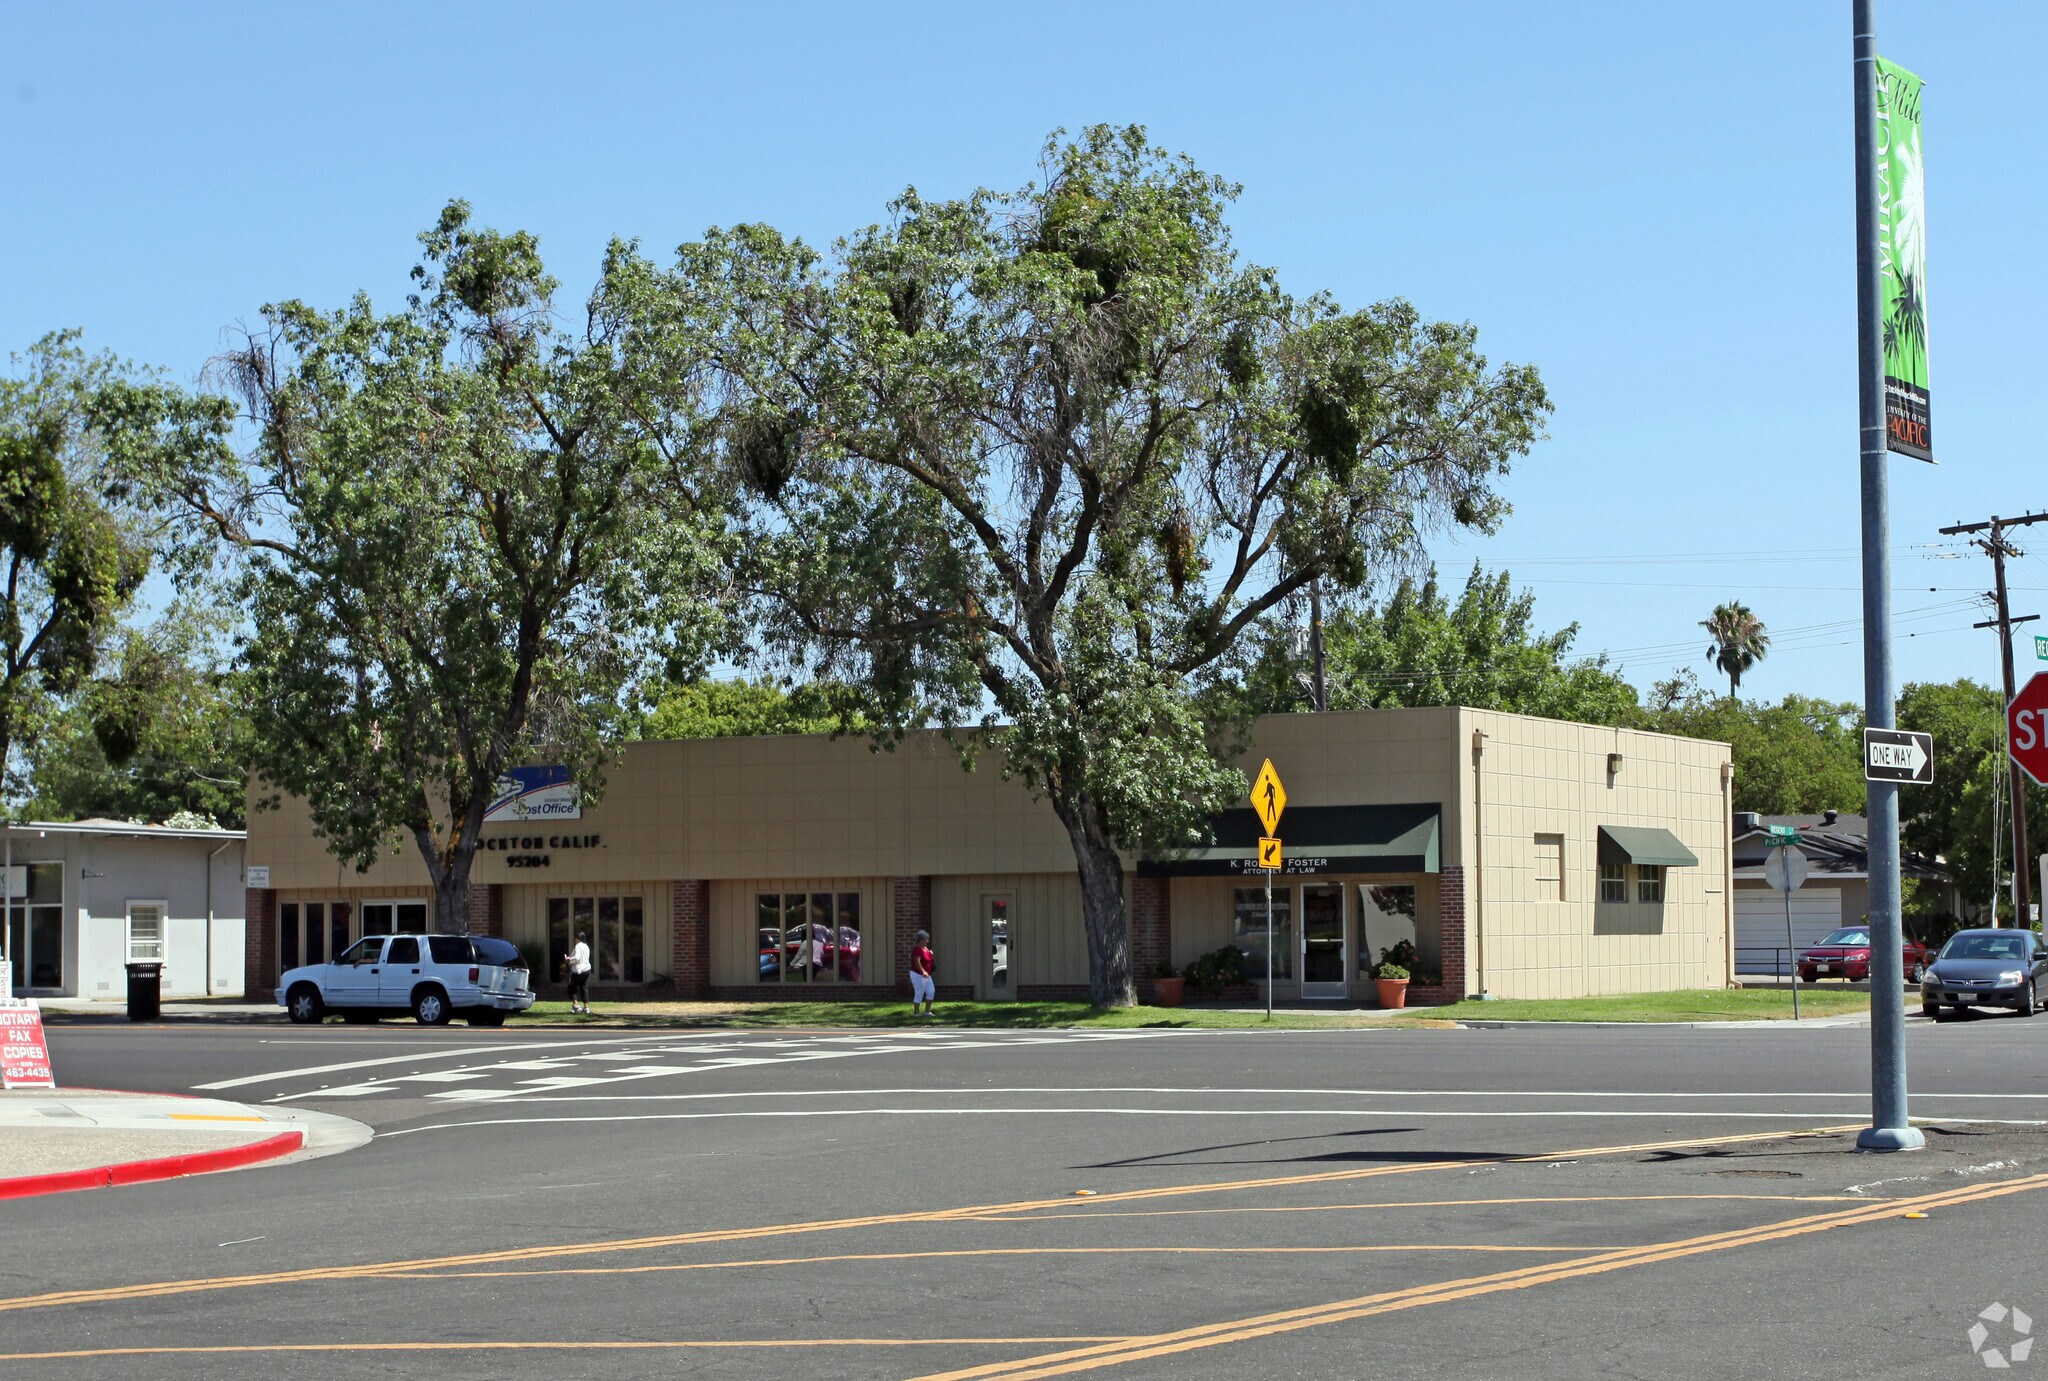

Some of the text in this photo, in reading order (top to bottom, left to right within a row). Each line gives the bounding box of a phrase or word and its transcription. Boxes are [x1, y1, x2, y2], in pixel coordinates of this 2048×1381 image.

[1879, 73, 1921, 124] Mile
[1873, 746, 1912, 766] ONE WAY
[525, 803, 574, 815] ost Office
[476, 836, 543, 850] OCKTON
[1230, 859, 1240, 868] K.
[1288, 858, 1328, 867] FOSTER
[8, 1029, 32, 1042] FAX
[3, 1046, 44, 1059] COPIES
